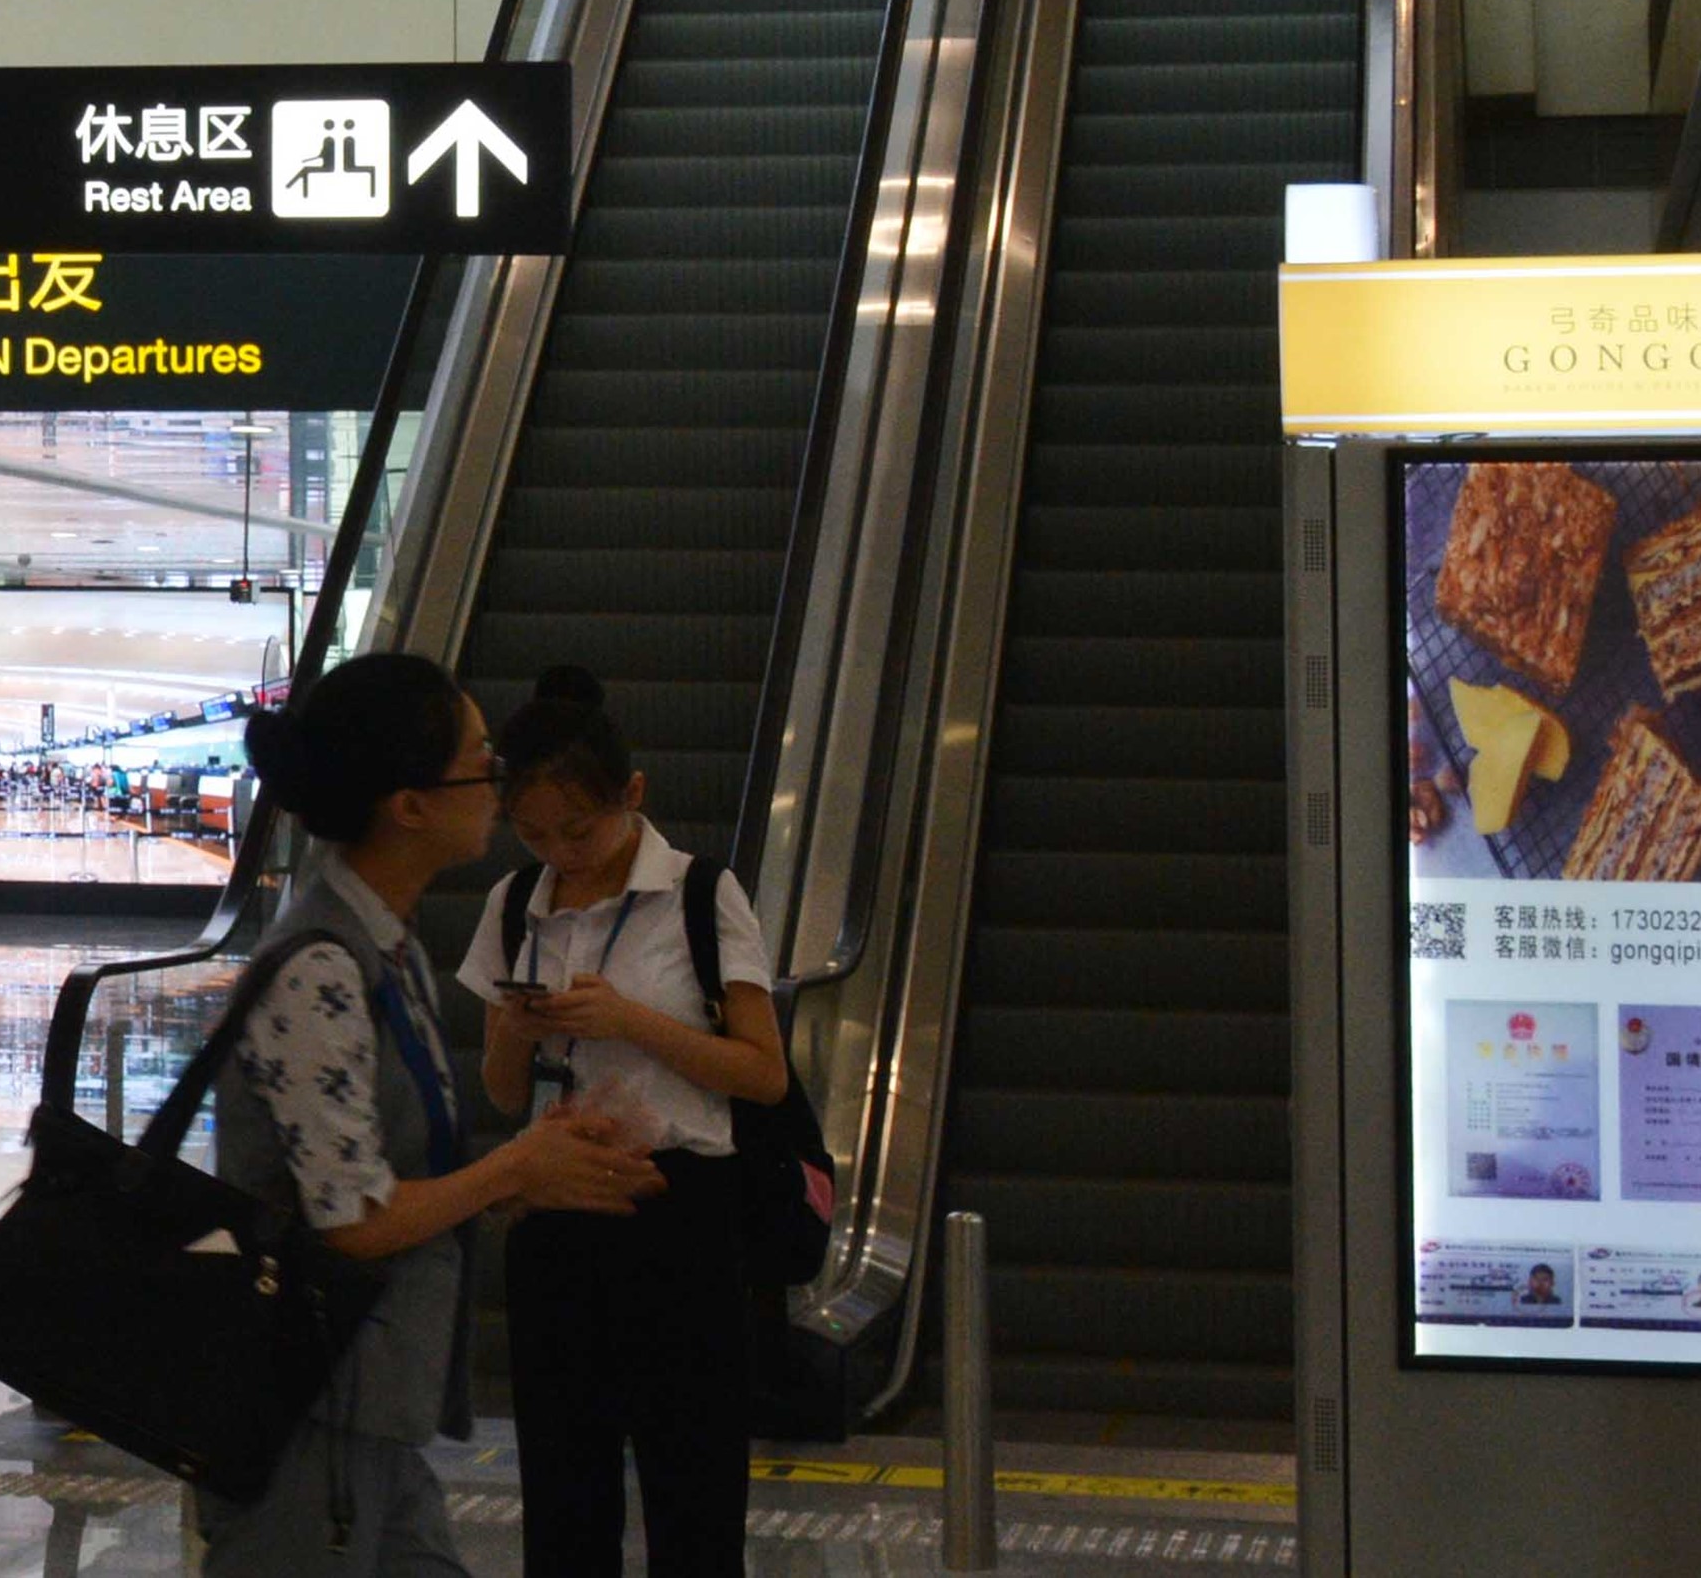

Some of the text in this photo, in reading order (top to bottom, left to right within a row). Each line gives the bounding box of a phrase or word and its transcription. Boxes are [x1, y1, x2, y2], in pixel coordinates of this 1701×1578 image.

[75, 103, 253, 165] 休息区
[84, 181, 251, 213] Rest Area
[1551, 302, 1699, 335] 弓奇品味
[25, 338, 262, 383] Departures
